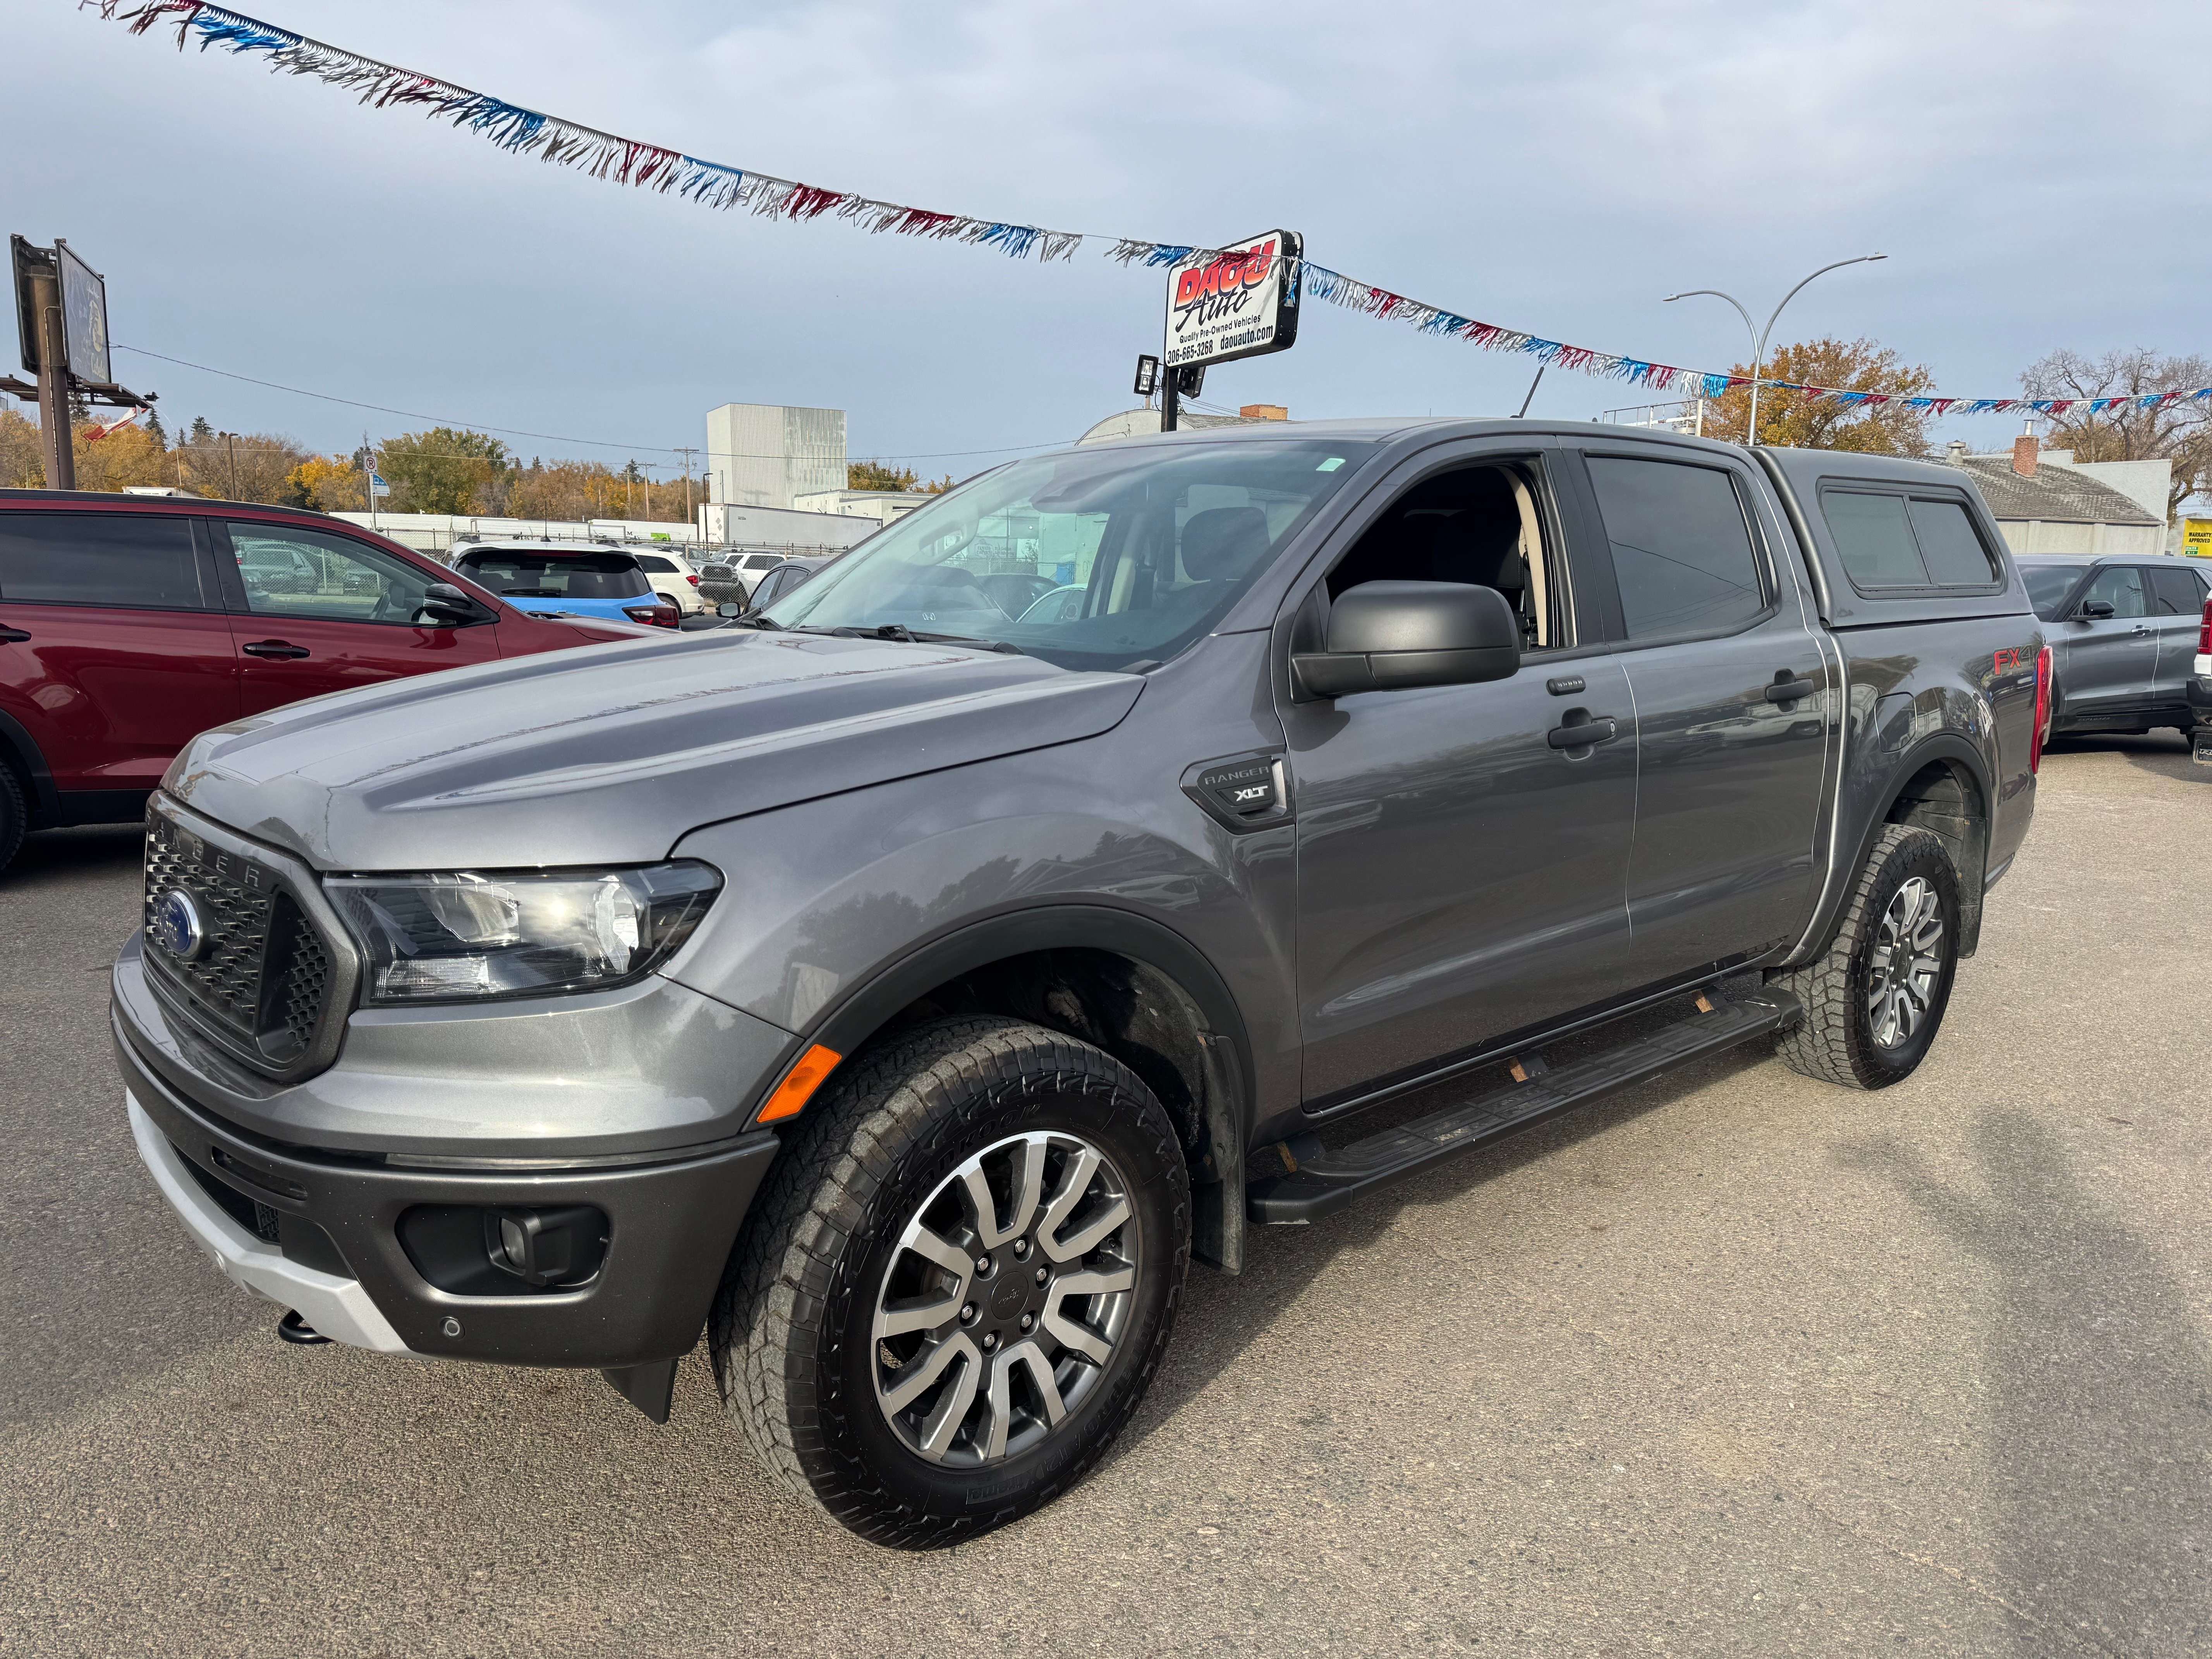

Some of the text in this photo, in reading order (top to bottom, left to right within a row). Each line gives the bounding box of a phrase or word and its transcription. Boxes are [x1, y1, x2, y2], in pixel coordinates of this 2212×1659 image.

[1173, 239, 1276, 313] DAOU
[1175, 288, 1252, 333] Auto
[1167, 325, 1273, 364] 306-665-3268 daouauto.com
[1180, 314, 1261, 344] Quality Pre-Owned Vehicles
[1993, 644, 2033, 676] FX4
[1205, 766, 1269, 785] RANGER
[1234, 785, 1268, 802] XLT
